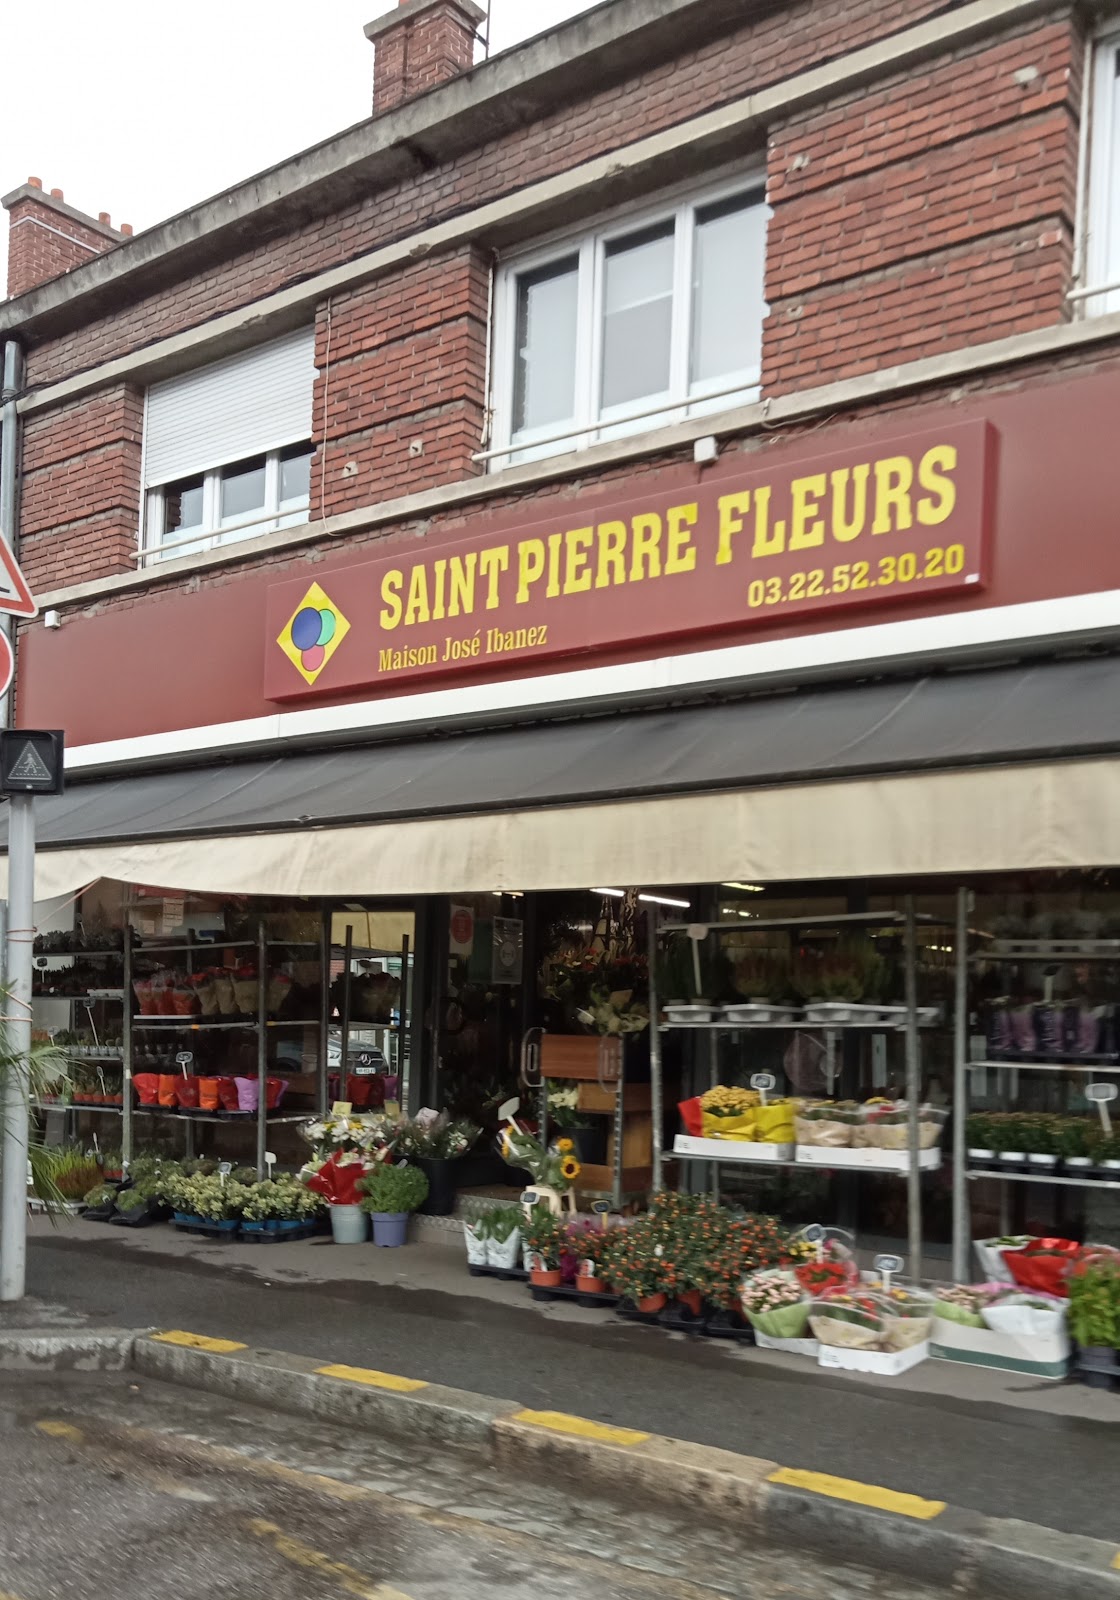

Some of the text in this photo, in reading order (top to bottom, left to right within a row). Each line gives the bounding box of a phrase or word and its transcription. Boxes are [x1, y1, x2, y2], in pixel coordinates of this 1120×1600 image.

[379, 444, 958, 631] SAINT PIERRE FLEURS
[747, 543, 966, 608] 03.22.52.30.20
[378, 624, 548, 672] Maison José Ibanez
